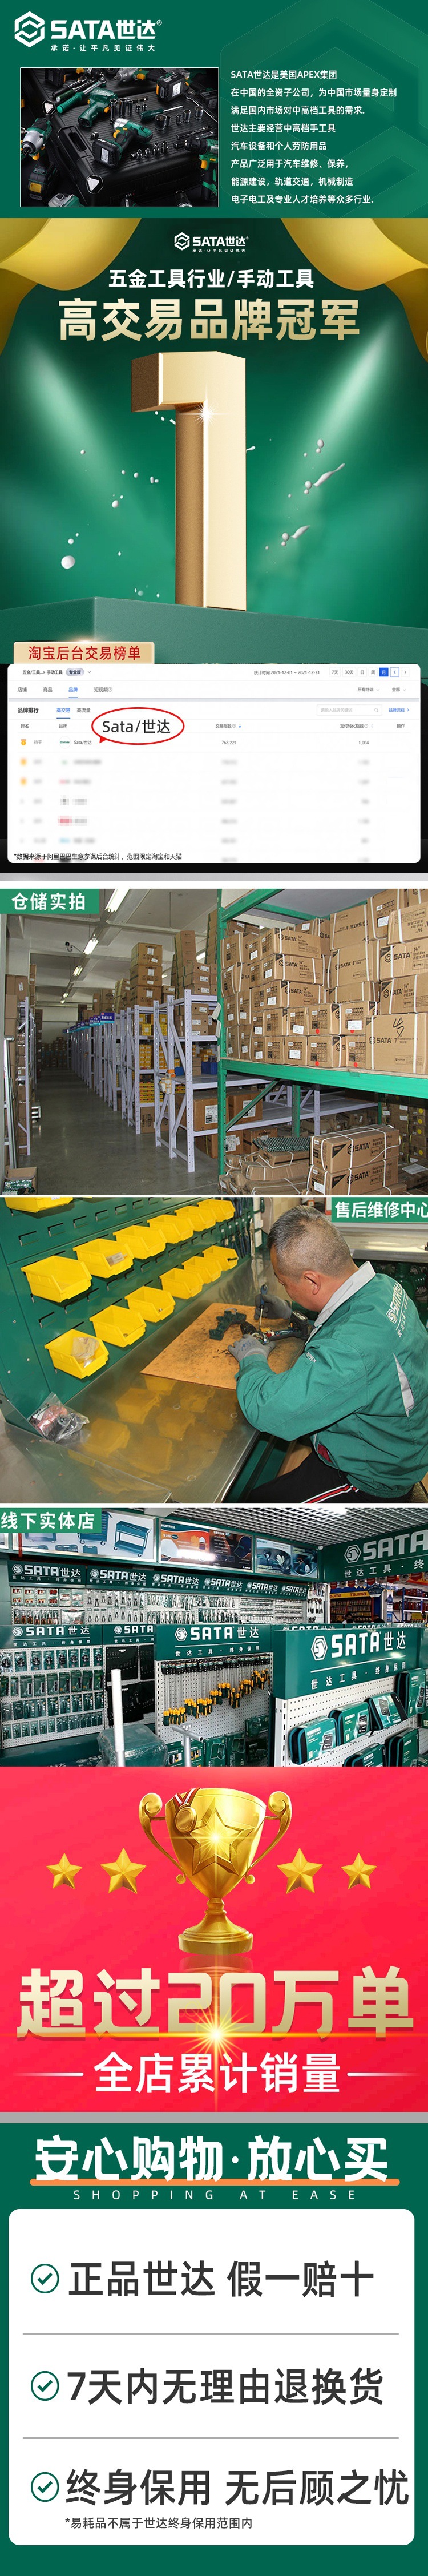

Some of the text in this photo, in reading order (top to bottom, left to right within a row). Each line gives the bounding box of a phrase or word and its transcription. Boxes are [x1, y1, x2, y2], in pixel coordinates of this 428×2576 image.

[231, 70, 337, 80] SATA世达是美国APEX集团
[231, 87, 397, 98] 在中国的全资子公司，为中国市场量身定制
[231, 105, 365, 115] 满足国内市场对中高档工具的需求.
[231, 123, 336, 133] 世达主要经营中高档手工具
[231, 141, 327, 151] 汽车设备和个人劳防用品
[231, 159, 349, 169] 产品广泛用于汽车维修、保养，
[231, 176, 353, 187] 能源建设，轨道交通，机械制造
[231, 194, 374, 204] 电子电工及专业人才培养等众多行业.
[108, 268, 314, 289] 五金工具行业/手动工具
[58, 297, 360, 342] 高交易品牌冠军
[29, 646, 141, 660] 淘宝后台交易榜单
[102, 719, 171, 734] Sata/世达
[354, 1143, 369, 1152] SATA
[354, 1171, 369, 1180] SATA
[124, 1625, 154, 1634] SATA
[17, 1965, 414, 2040] 超过20万单
[94, 2051, 341, 2094] 全店累计销量
[35, 2134, 389, 2183] 安心购物·放心买
[74, 2190, 355, 2200] SHOPPING AT EASE
[68, 2260, 374, 2298] 正品世达 假一赔十
[67, 2367, 384, 2406] 7天内无理由退换货
[66, 2468, 409, 2506] 终身保用 无后顾之忧
